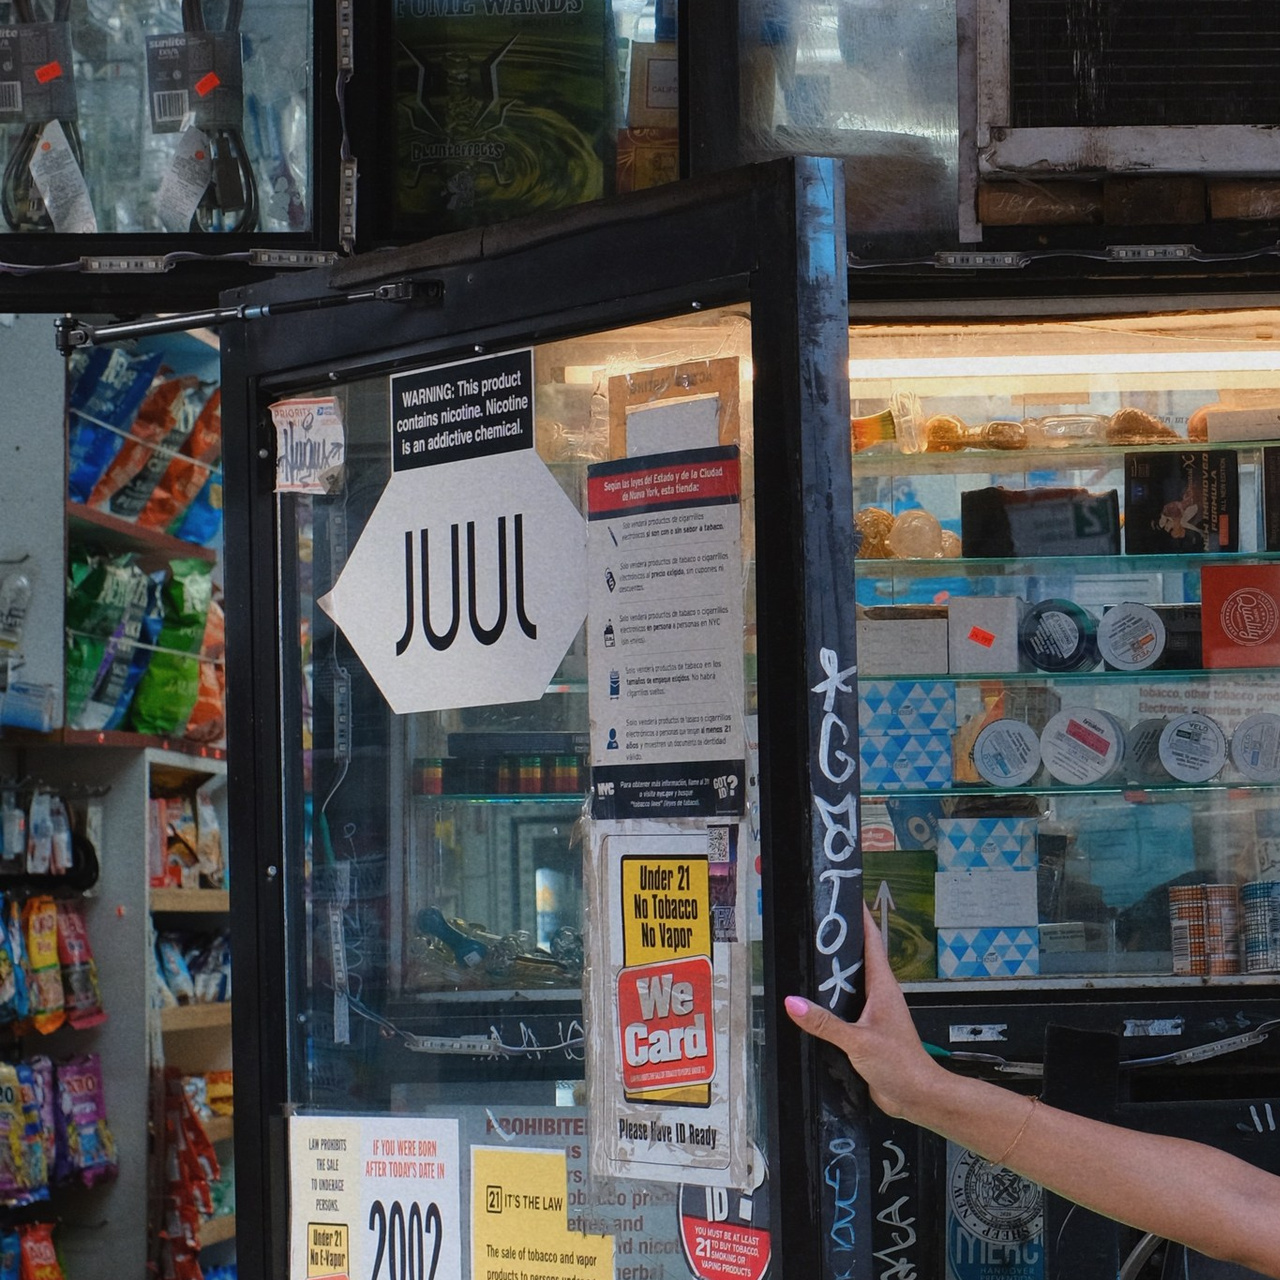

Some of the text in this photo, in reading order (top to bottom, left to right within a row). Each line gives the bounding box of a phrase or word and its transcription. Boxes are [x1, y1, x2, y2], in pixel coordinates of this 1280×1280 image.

[149, 37, 186, 48] sunlite
[402, 370, 521, 409] WARNING: This product
[396, 394, 528, 433] contains nicotine. Nicotine
[402, 418, 523, 456] is an addictive chemical.
[396, 513, 537, 657] JUUL
[640, 865, 690, 891] Under 21
[634, 894, 698, 920] No Tobacco
[642, 922, 692, 953] No Vapor
[636, 973, 694, 1021] We
[624, 1014, 708, 1068] Card
[309, 1138, 347, 1151] LAW PROHIBITS
[619, 1118, 717, 1151] Please Have ID Ready
[373, 1139, 437, 1158] IF YOU WERE BORN
[316, 1158, 339, 1172] THE SALE
[366, 1161, 445, 1180] AFTER TODAY'S DATE IN
[311, 1178, 345, 1192] TO UNDERAGE
[488, 1190, 563, 1212] 21 IT'S THE LAW
[313, 1228, 343, 1247] Under 21
[695, 1224, 760, 1246] YOU MUST BE AT LEAST
[486, 1244, 597, 1268] The sale of tobacco and vapor
[695, 1237, 711, 1258] 21
[711, 1238, 760, 1258] TO BUY TOBACCO,
[711, 1250, 746, 1265] SMOKING OR
[310, 1248, 346, 1270] No E-Vapor
[701, 1258, 751, 1278] VAPING PRODUCTS
